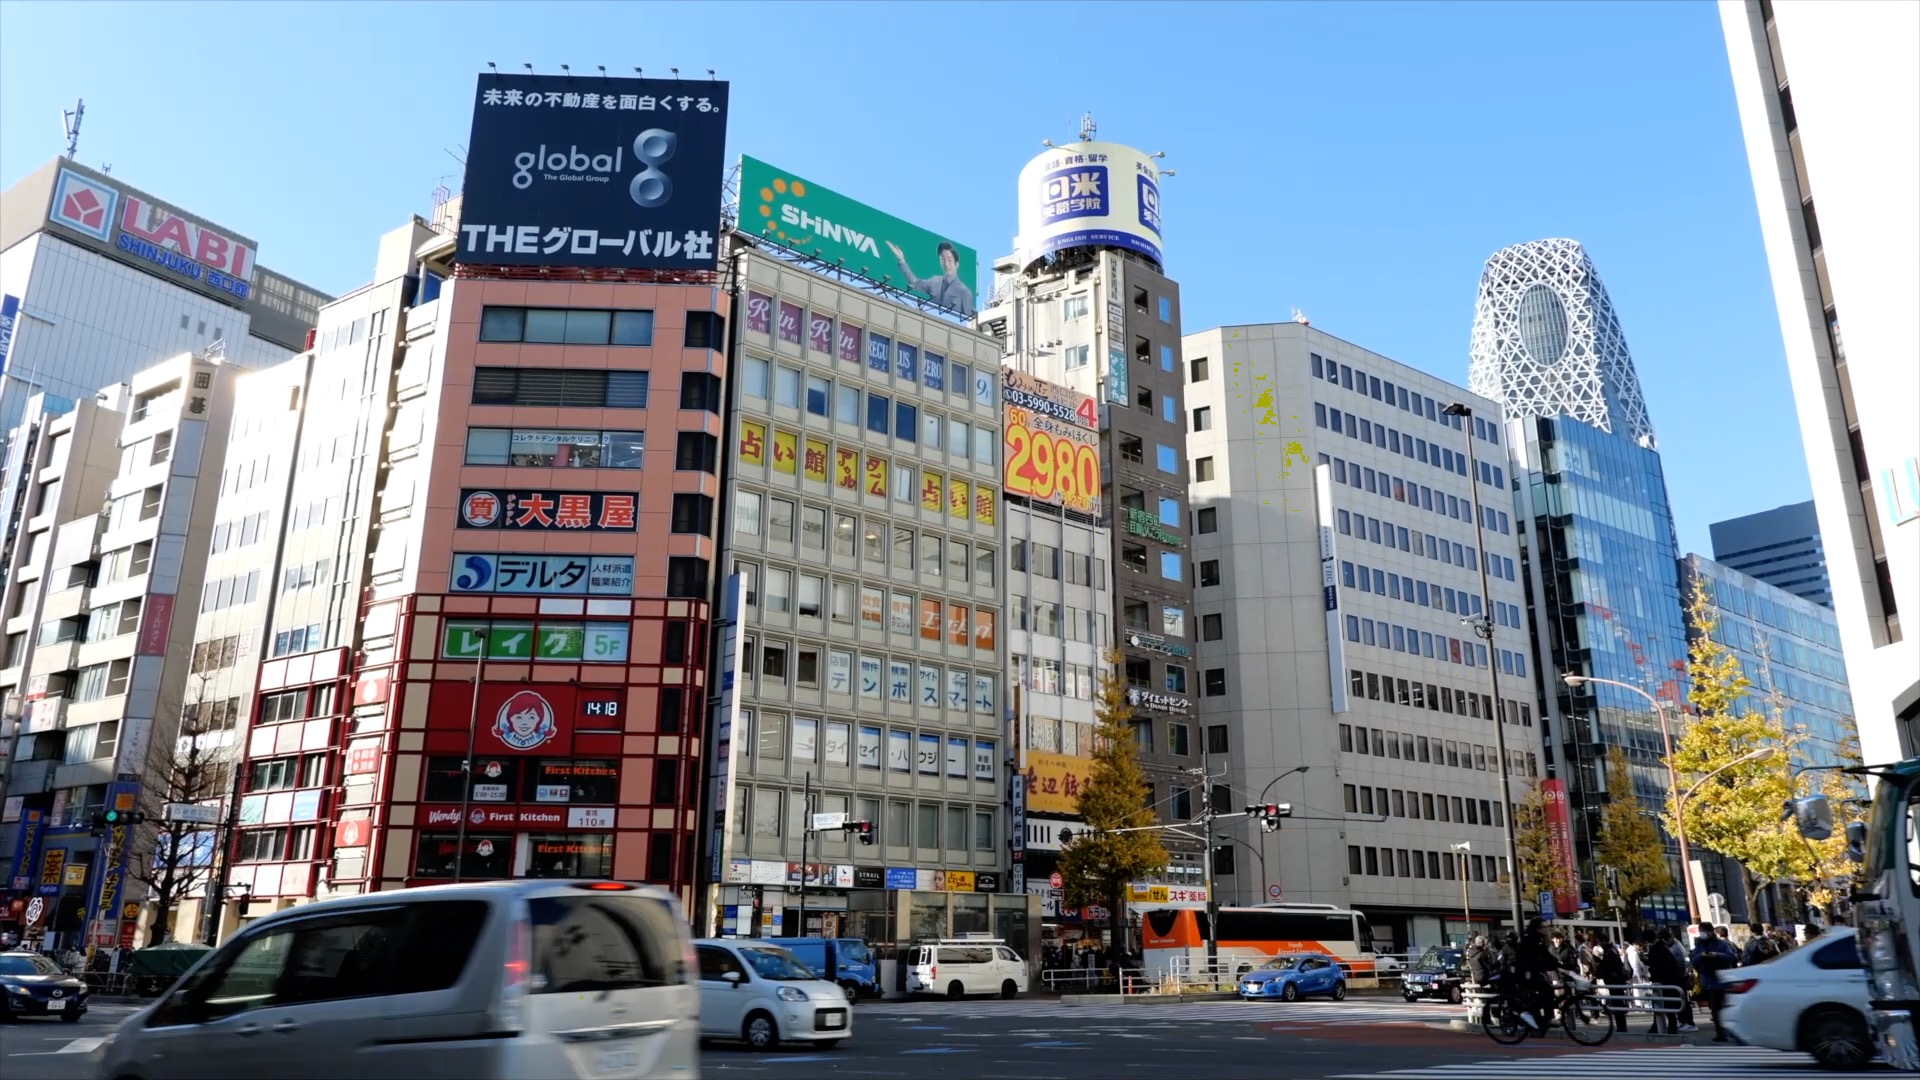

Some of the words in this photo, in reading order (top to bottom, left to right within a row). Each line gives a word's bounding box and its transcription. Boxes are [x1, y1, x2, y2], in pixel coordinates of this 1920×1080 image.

[483, 88, 720, 113] 未来の不動産を面白くする。
[512, 144, 623, 189] global
[544, 174, 556, 182] The
[559, 174, 583, 183] Global
[585, 175, 609, 184] Group
[121, 195, 248, 278] LABI
[461, 224, 713, 260] THEグローバル社
[117, 234, 201, 281] SHINJUKU
[206, 270, 249, 299] 西口館
[1012, 389, 1076, 423] 03-5990-5528
[1076, 397, 1098, 429] 4
[740, 429, 826, 475] 占い館
[1006, 422, 1100, 500] 2980
[467, 496, 496, 522] 質
[516, 493, 636, 529] 大黒屋
[499, 560, 587, 589] デルタ
[592, 563, 632, 574] 人材派遣
[460, 630, 568, 656] レイク
[593, 633, 621, 656] 5F
[587, 701, 617, 716] 14:18
[490, 813, 514, 822] First
[520, 813, 560, 822] Kitchen
[1541, 893, 1549, 905] P
